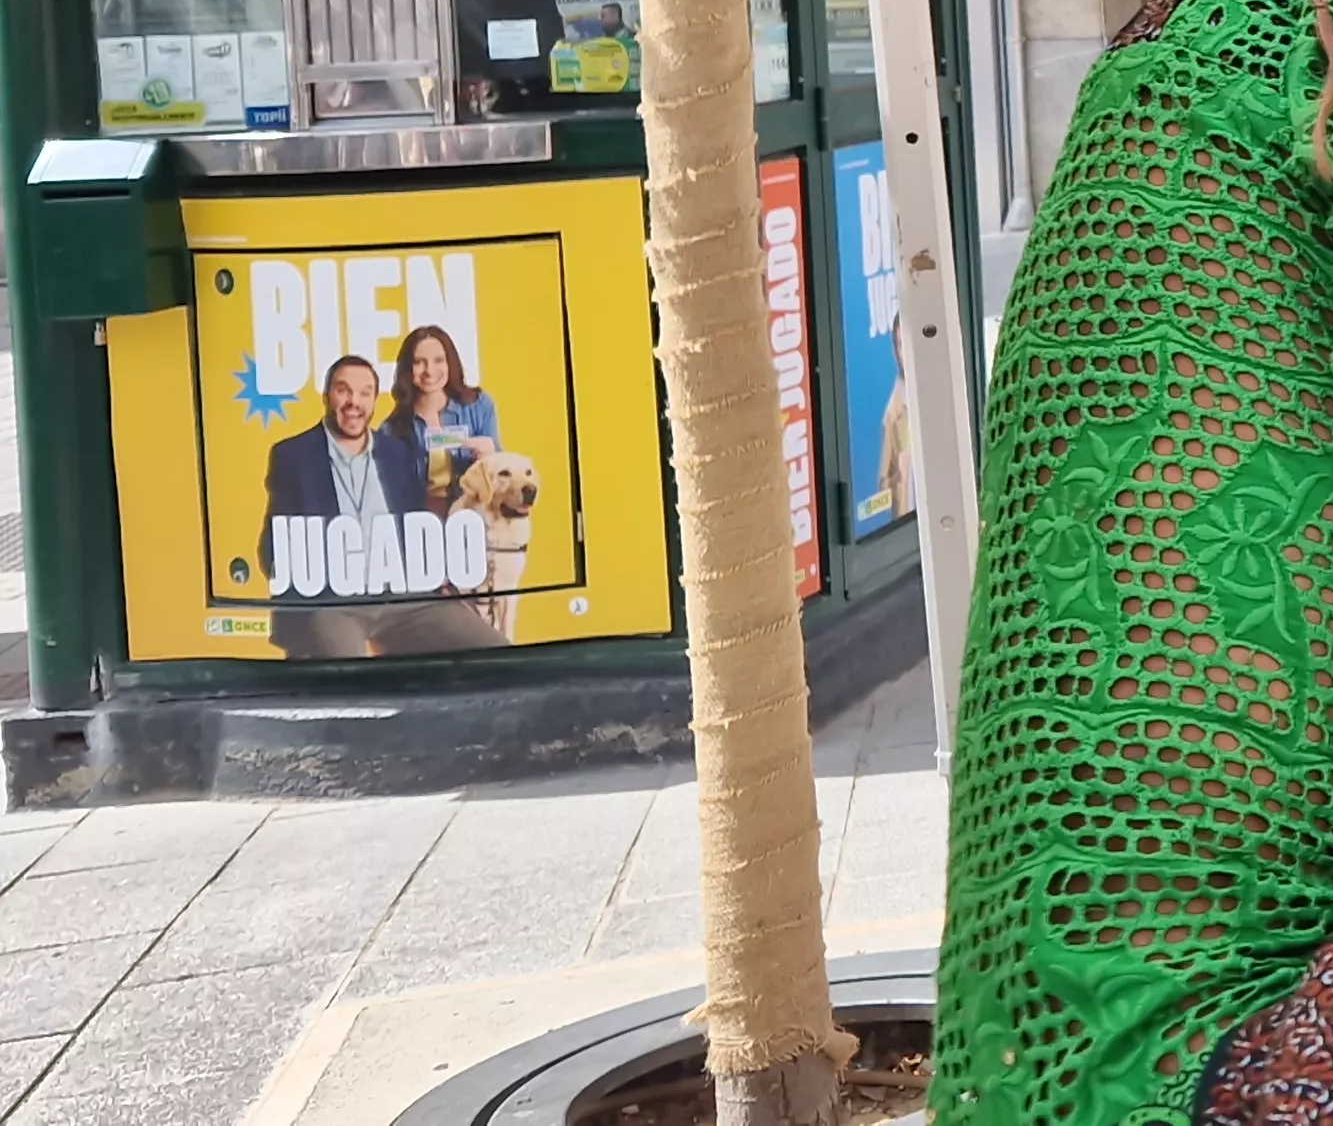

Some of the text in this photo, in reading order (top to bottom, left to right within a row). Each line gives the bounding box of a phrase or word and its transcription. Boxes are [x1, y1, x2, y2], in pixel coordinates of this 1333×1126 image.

[250, 252, 481, 396] BIEN
[764, 205, 806, 411] JUGADO
[269, 509, 488, 597] JUGADO
